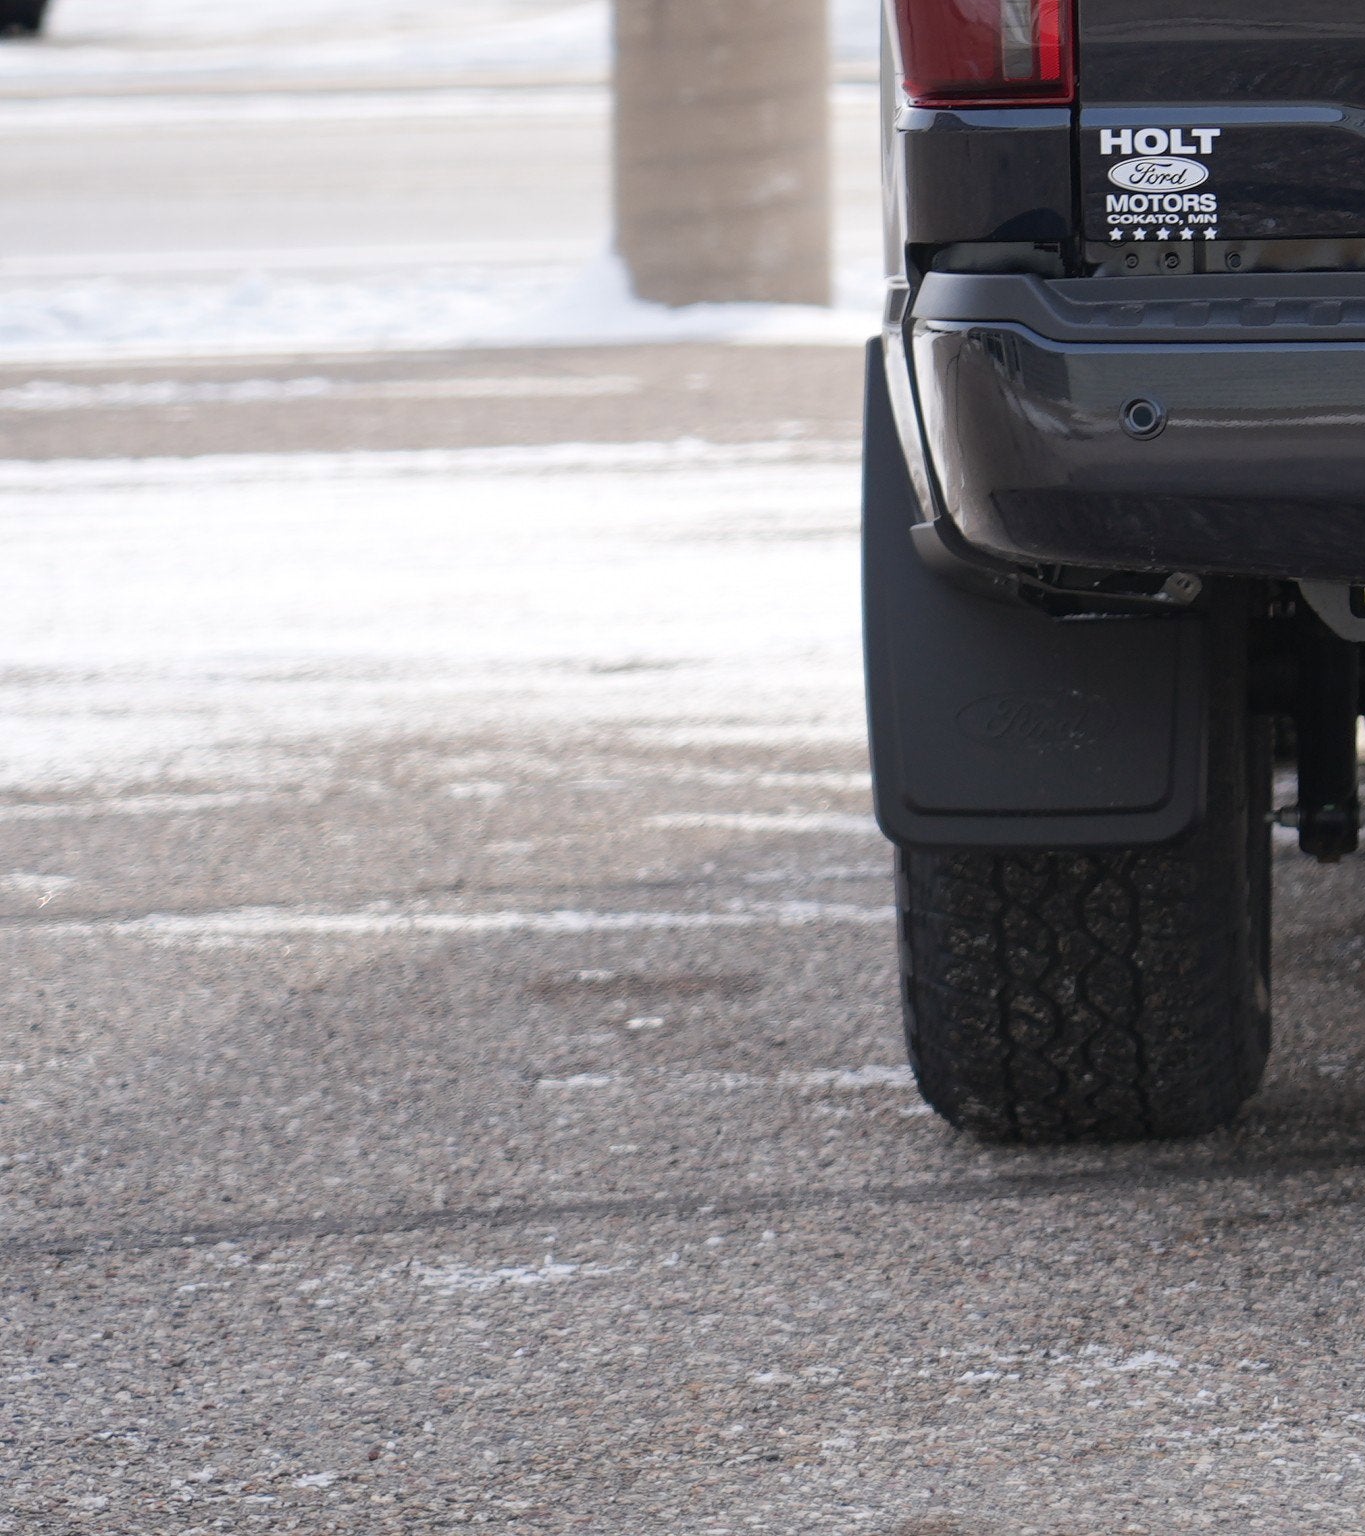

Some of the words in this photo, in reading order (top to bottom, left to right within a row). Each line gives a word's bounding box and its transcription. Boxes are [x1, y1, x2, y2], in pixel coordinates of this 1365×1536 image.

[1100, 127, 1221, 155] HOLT
[1129, 162, 1188, 185] Ford
[1106, 193, 1217, 213] MOTORS
[1107, 214, 1184, 226] COKATO,
[1188, 214, 1218, 224] MN
